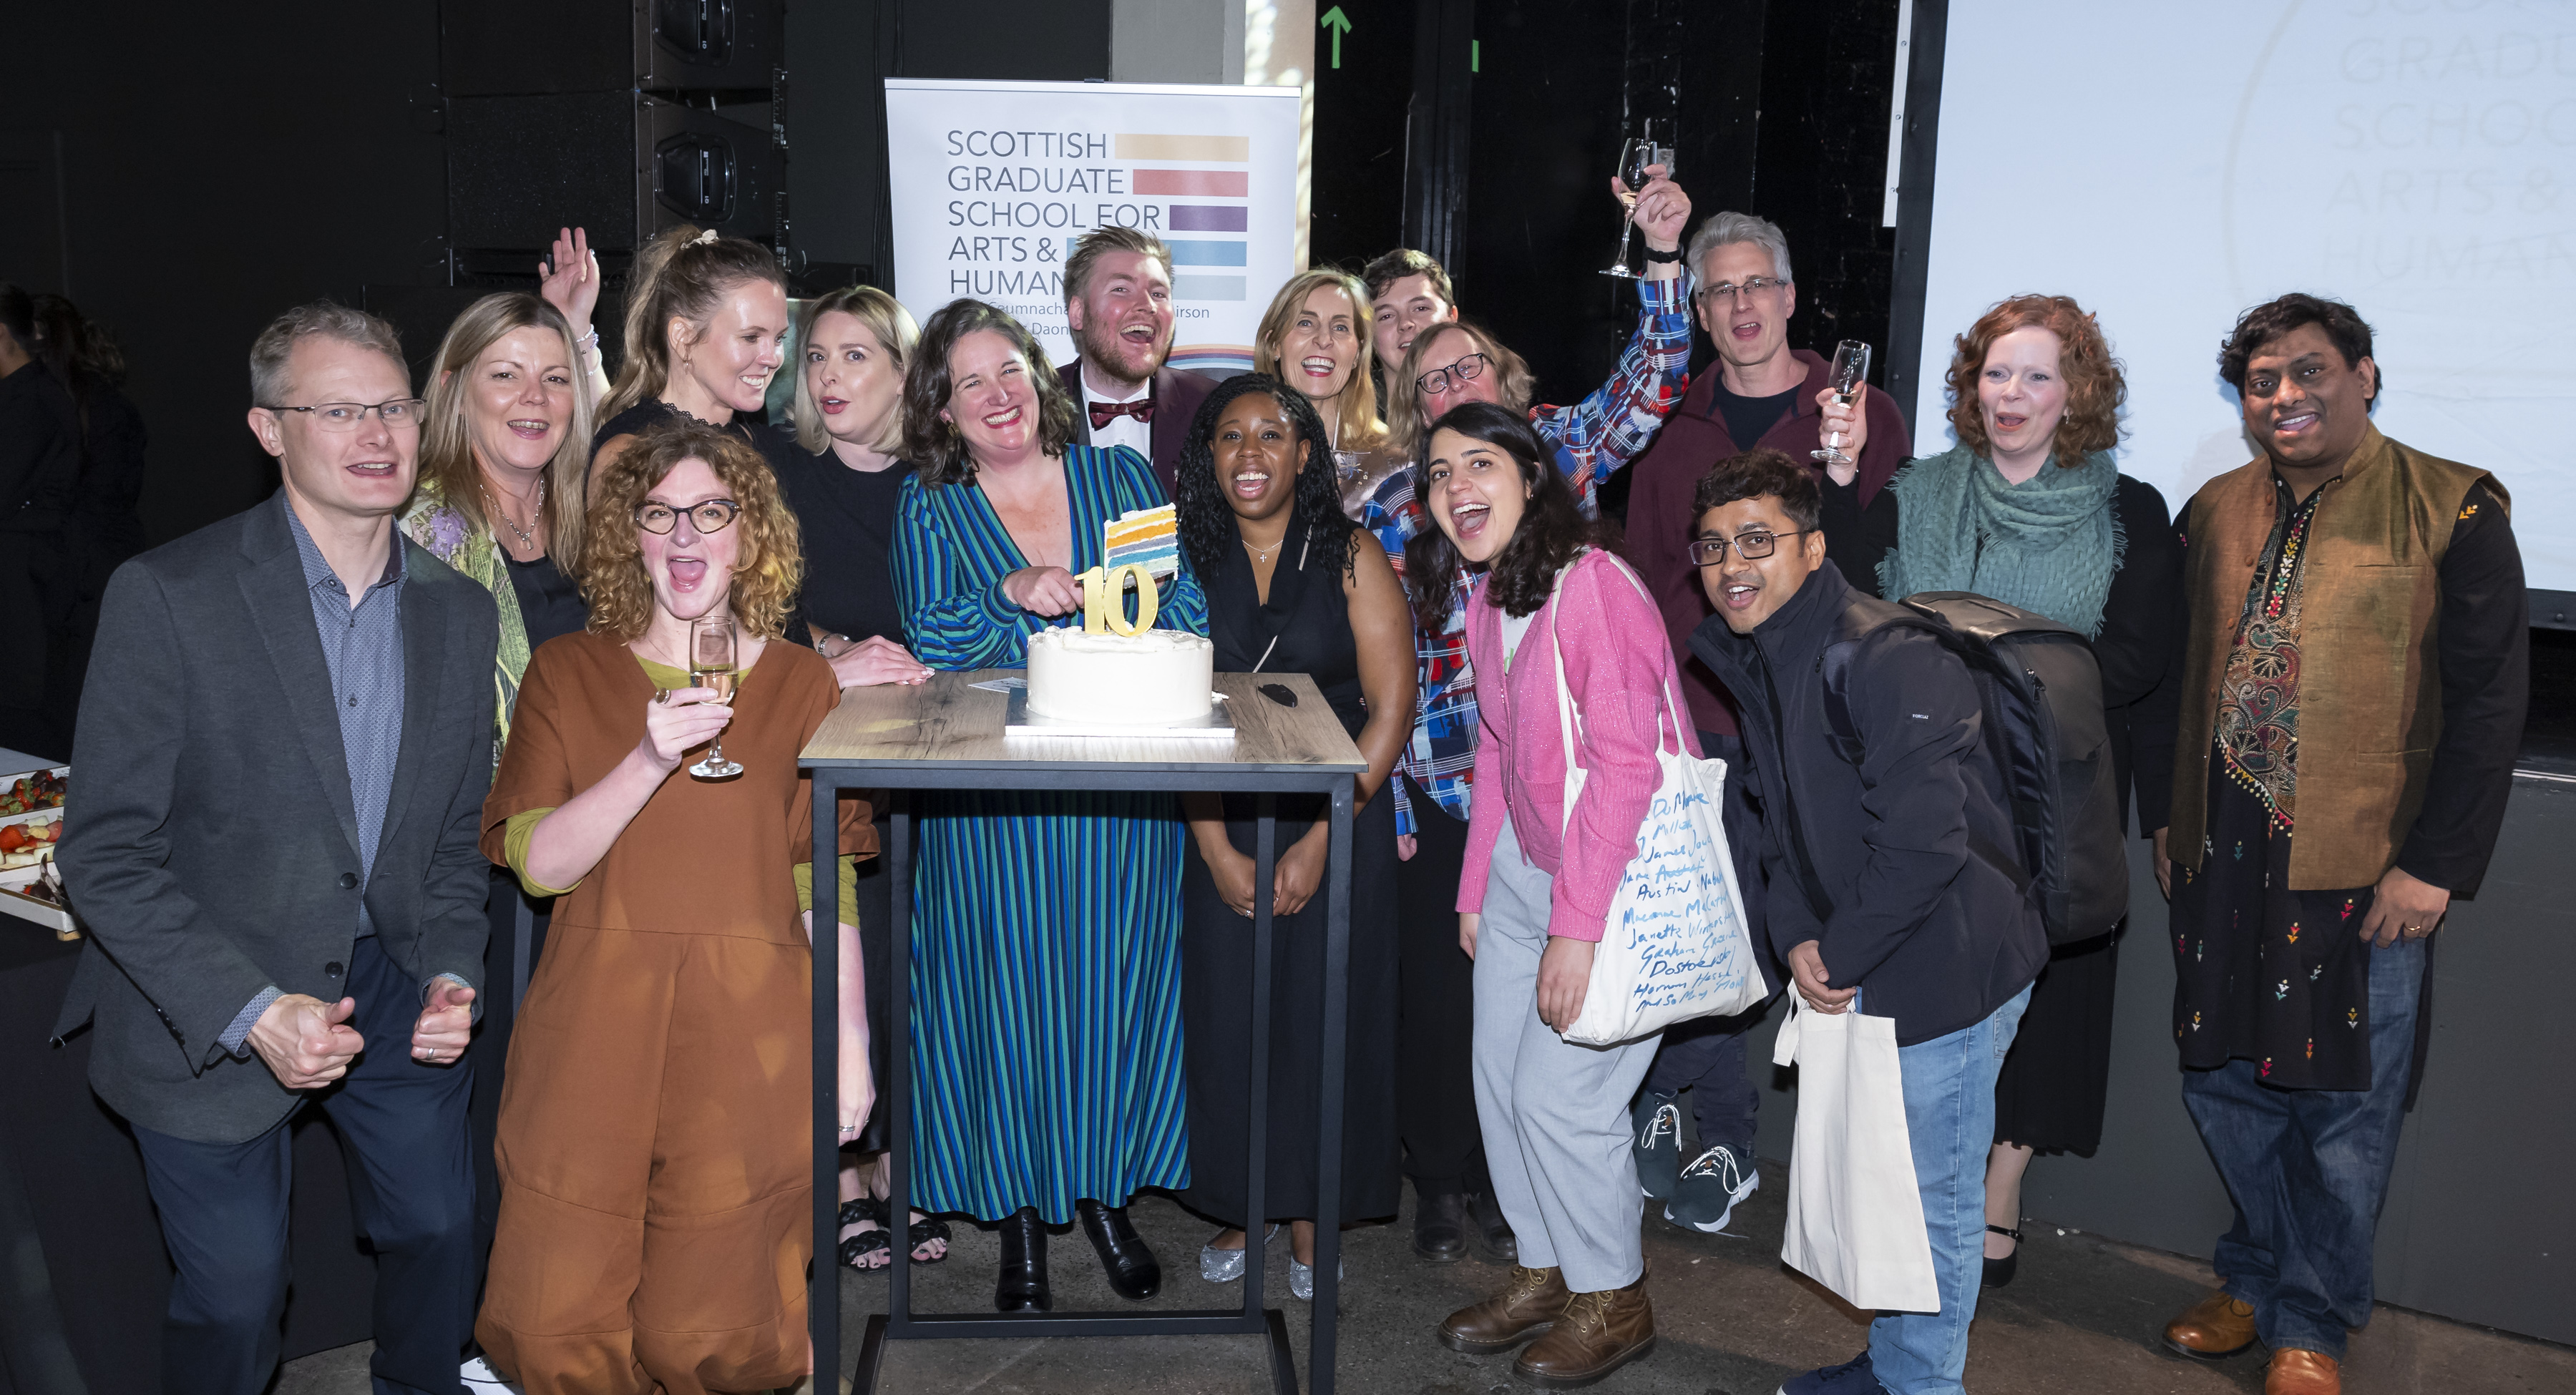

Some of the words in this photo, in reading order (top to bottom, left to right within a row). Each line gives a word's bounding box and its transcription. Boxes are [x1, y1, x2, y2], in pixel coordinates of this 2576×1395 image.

[947, 129, 1106, 159] SCOTTISH
[948, 165, 1124, 195] GRADUATE
[2324, 167, 2497, 215] ARTS
[2517, 166, 2563, 215] &
[948, 200, 1086, 228] SCHOOL
[1097, 204, 1160, 230] FOR
[948, 236, 1028, 263] ARTS
[1037, 237, 1058, 263] &
[1073, 564, 1159, 637] 10
[1662, 994, 1677, 1006] So
